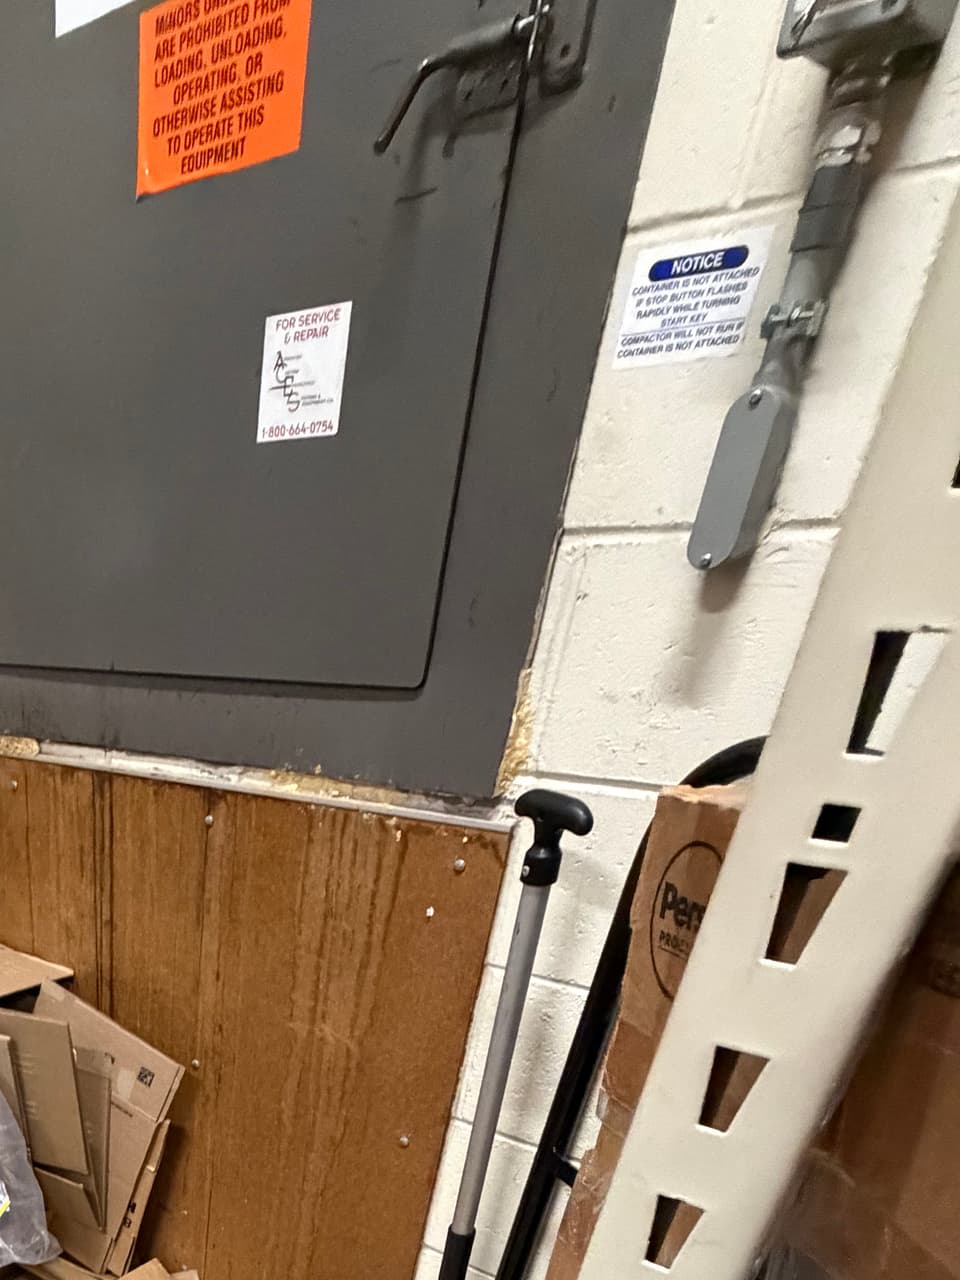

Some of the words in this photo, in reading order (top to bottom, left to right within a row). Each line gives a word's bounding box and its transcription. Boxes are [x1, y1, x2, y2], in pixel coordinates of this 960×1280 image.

[155, 2, 200, 37] MINORS
[154, 36, 175, 62] ARE
[179, 3, 250, 52] PROHIBITED
[154, 50, 207, 88] LOADING,
[211, 15, 287, 64] UNLOADING,
[245, 52, 263, 78] OR
[153, 96, 217, 138] OTHERWISE
[220, 70, 284, 115] ASSISTING
[167, 135, 181, 156] TO
[184, 115, 234, 151] OPERATE
[238, 104, 265, 133] THIS
[181, 136, 246, 175] EQUIPMENT
[670, 250, 725, 275] NOTICE
[632, 280, 679, 296] CONTAINER
[681, 279, 690, 289] IS
[693, 275, 710, 287] NOT
[712, 266, 760, 283] ATTACHED
[645, 294, 669, 306] STOP
[669, 289, 704, 304] BUTTON
[707, 281, 748, 297] FLASHES
[276, 316, 297, 332] FOR
[299, 308, 342, 328] SERVICE
[636, 306, 671, 320] RAPIDLY
[673, 302, 699, 315] WHILE
[701, 295, 741, 310] TURNING
[660, 316, 687, 328] START
[689, 313, 708, 324] KEY
[293, 325, 329, 343] REPAIR
[617, 344, 664, 359] CONTAINER
[665, 342, 674, 353] IS
[675, 339, 692, 352] NOT
[694, 334, 739, 350] ATTACHED
[621, 332, 672, 347] COMPACTOR
[673, 329, 693, 340] WILL
[695, 325, 713, 337] NOT
[716, 323, 734, 335] RUN
[262, 420, 334, 439] 1-800-664-0754
[659, 880, 707, 934] Pers
